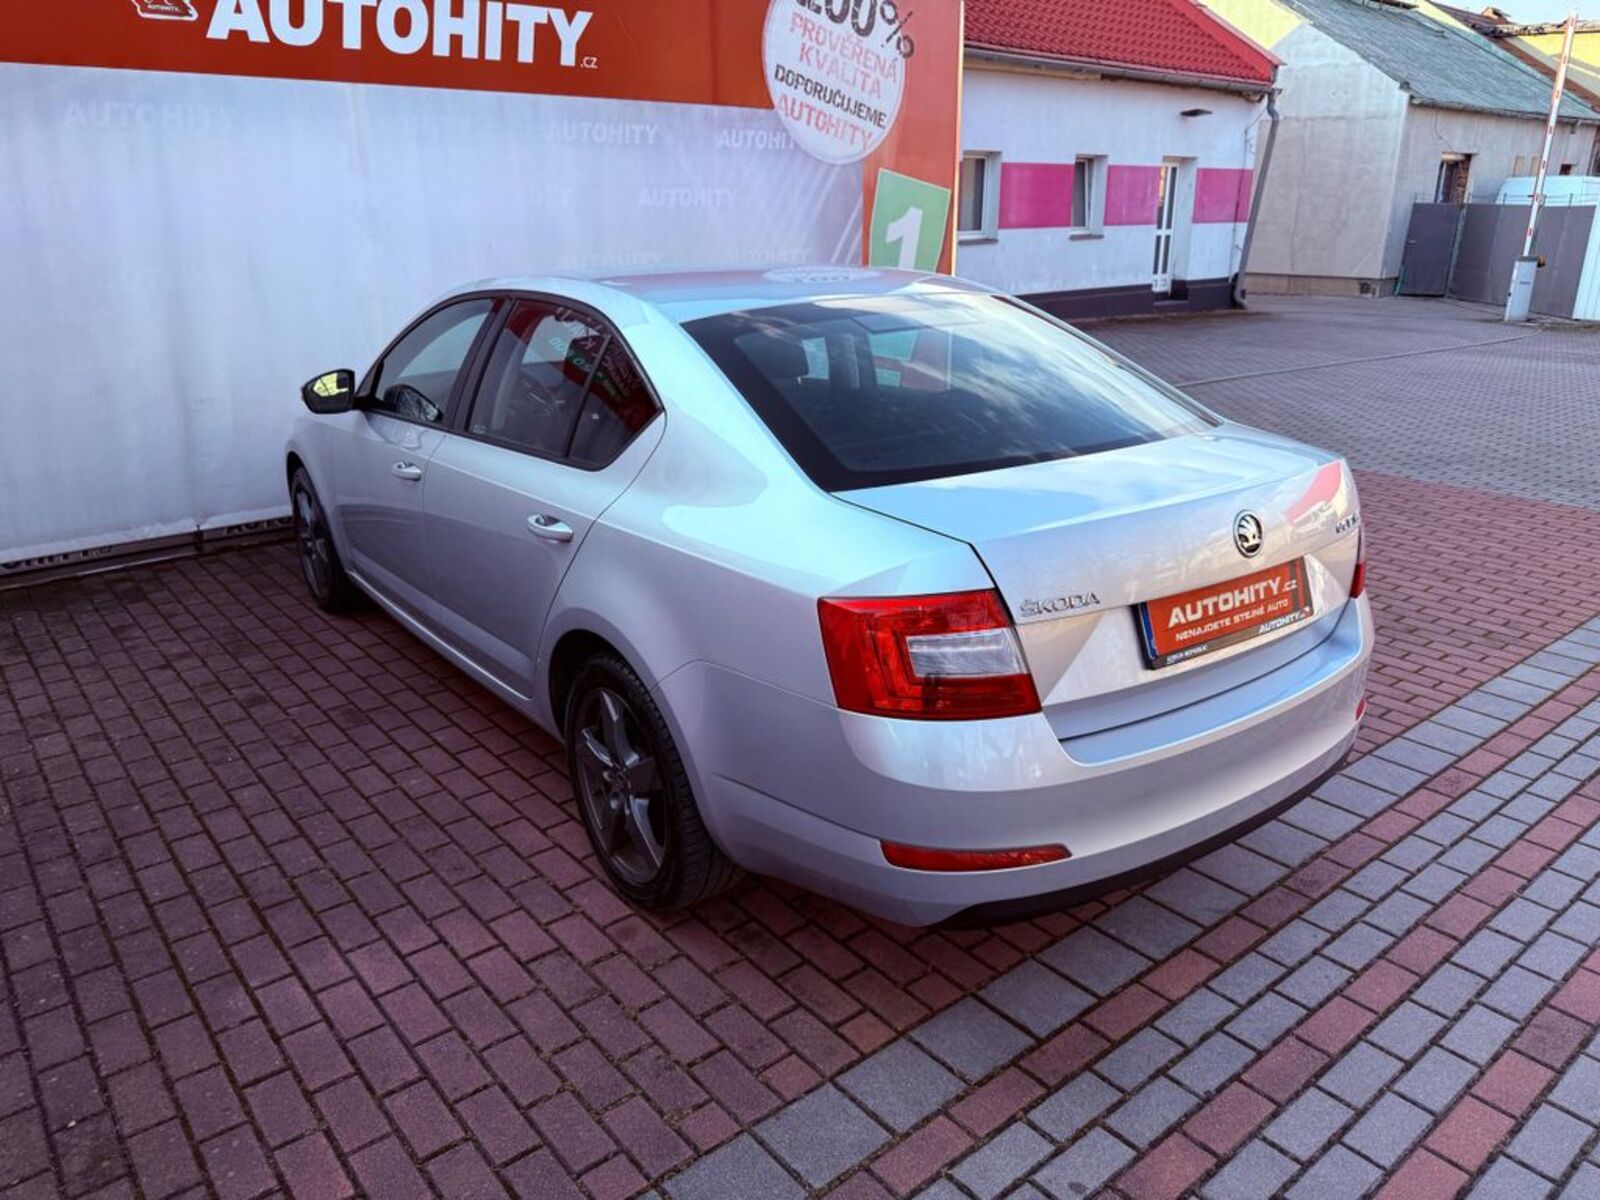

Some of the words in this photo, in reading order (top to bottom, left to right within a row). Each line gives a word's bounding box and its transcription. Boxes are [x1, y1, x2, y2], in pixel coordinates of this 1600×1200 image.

[774, 63, 888, 130] DOPORUČUJEME
[799, 42, 882, 100] KVALITA
[776, 94, 874, 151] AUTOHITY
[1020, 591, 1101, 617] ŠKODA
[1175, 616, 1232, 641] NENAJDETE
[1267, 598, 1289, 613] AUTO
